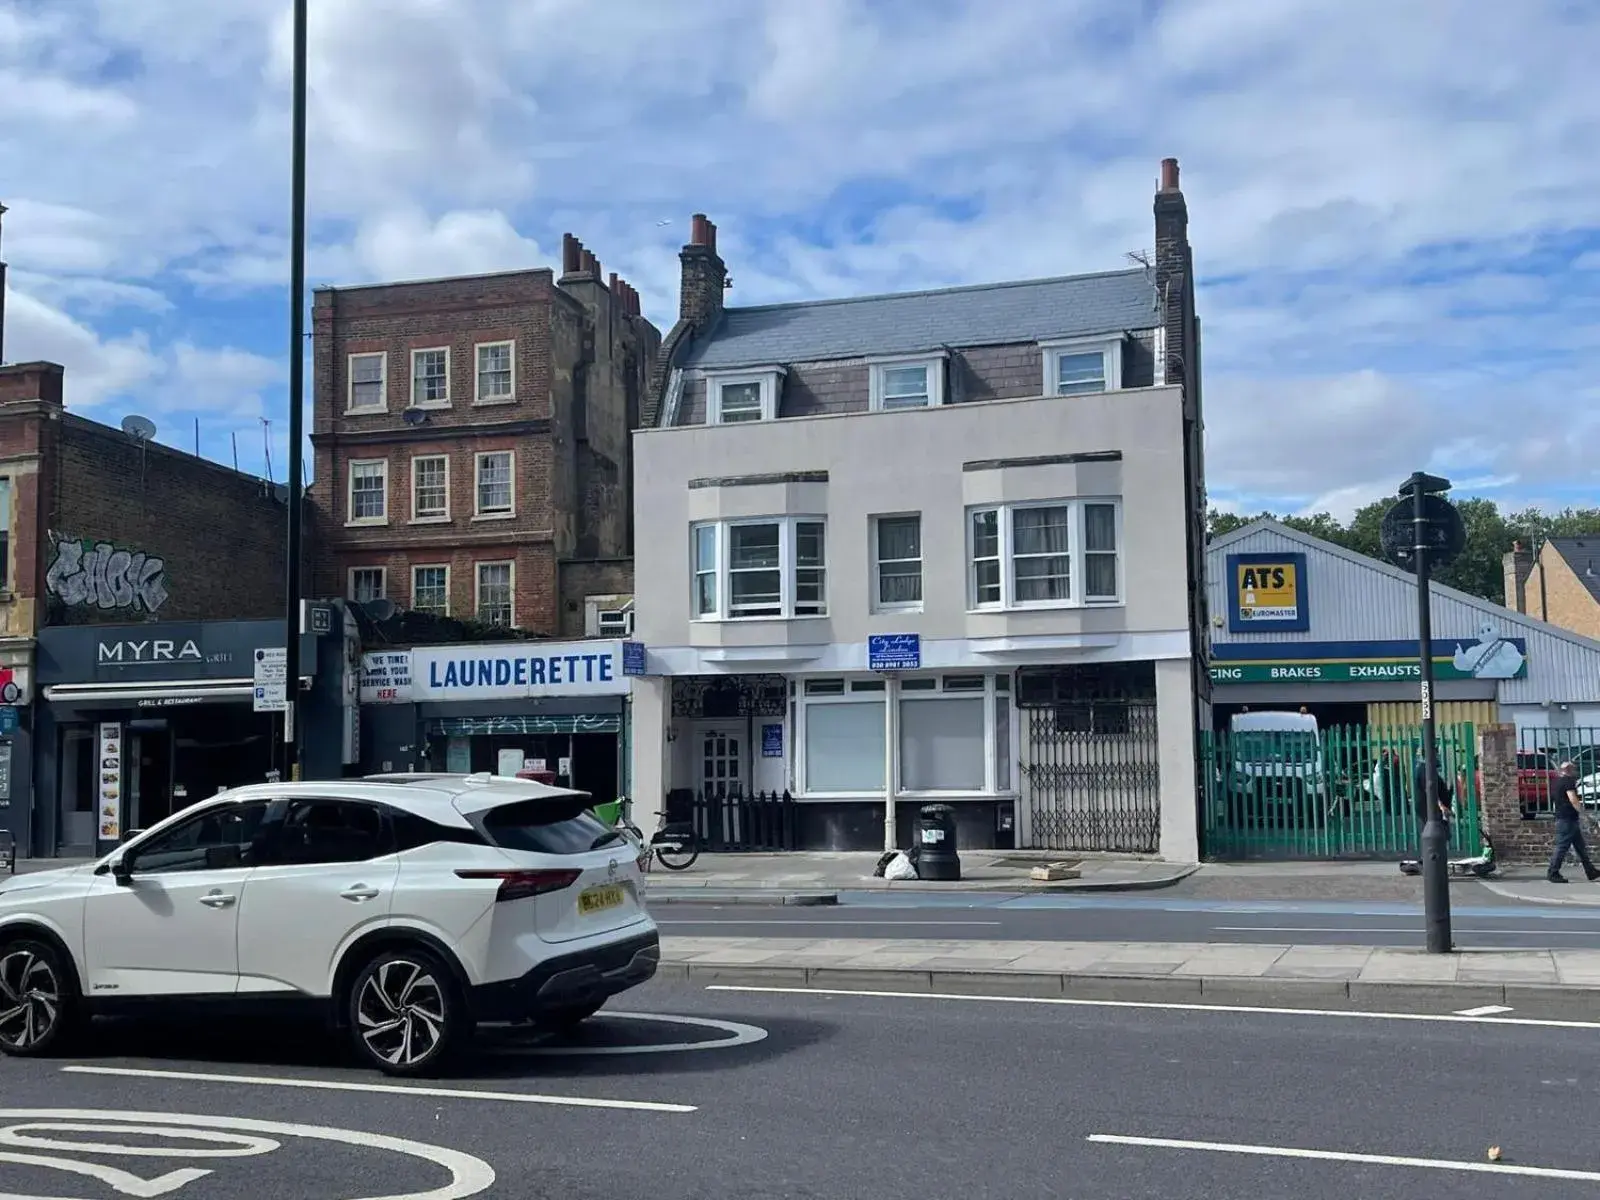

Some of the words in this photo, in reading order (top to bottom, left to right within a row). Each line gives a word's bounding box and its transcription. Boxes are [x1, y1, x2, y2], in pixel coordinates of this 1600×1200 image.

[1242, 568, 1285, 589] ATS
[99, 640, 201, 661] MYRA
[430, 654, 613, 688] LAUNDERETTE
[1271, 667, 1321, 678] BRAKES
[1350, 665, 1420, 676] EXHAUSTS
[362, 678, 391, 687] SERVICE
[378, 688, 397, 698] HERE
